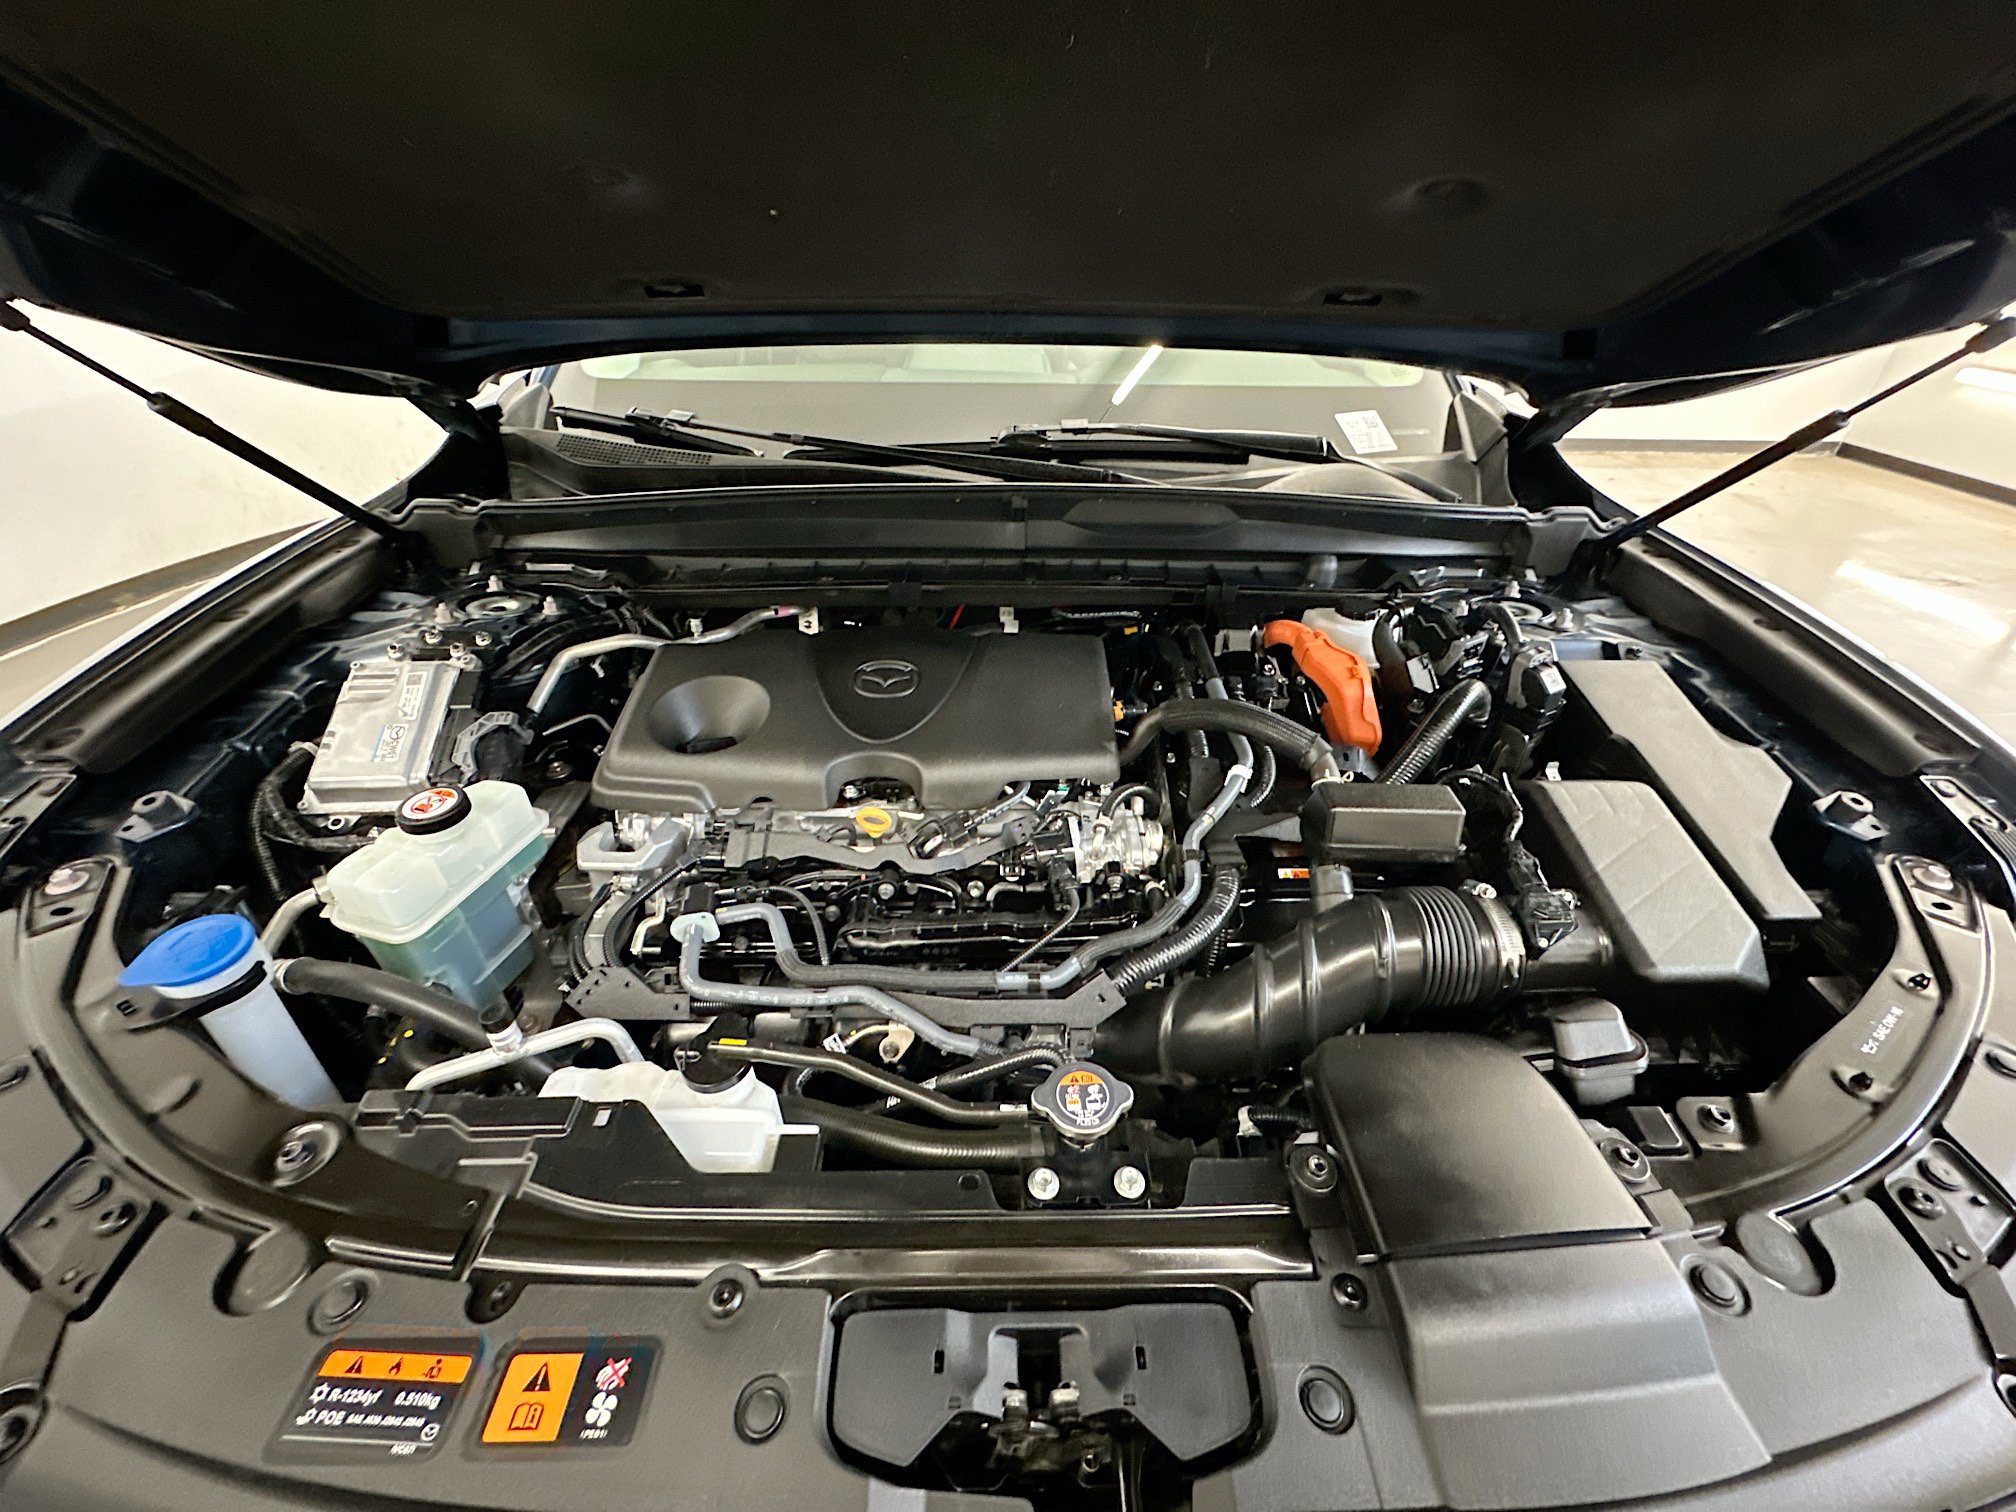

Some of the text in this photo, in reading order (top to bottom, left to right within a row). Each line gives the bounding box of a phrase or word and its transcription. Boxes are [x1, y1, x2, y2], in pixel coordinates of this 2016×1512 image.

[327, 1387, 442, 1410] R-1234yf 0.510kg
[315, 1409, 346, 1425] POE
